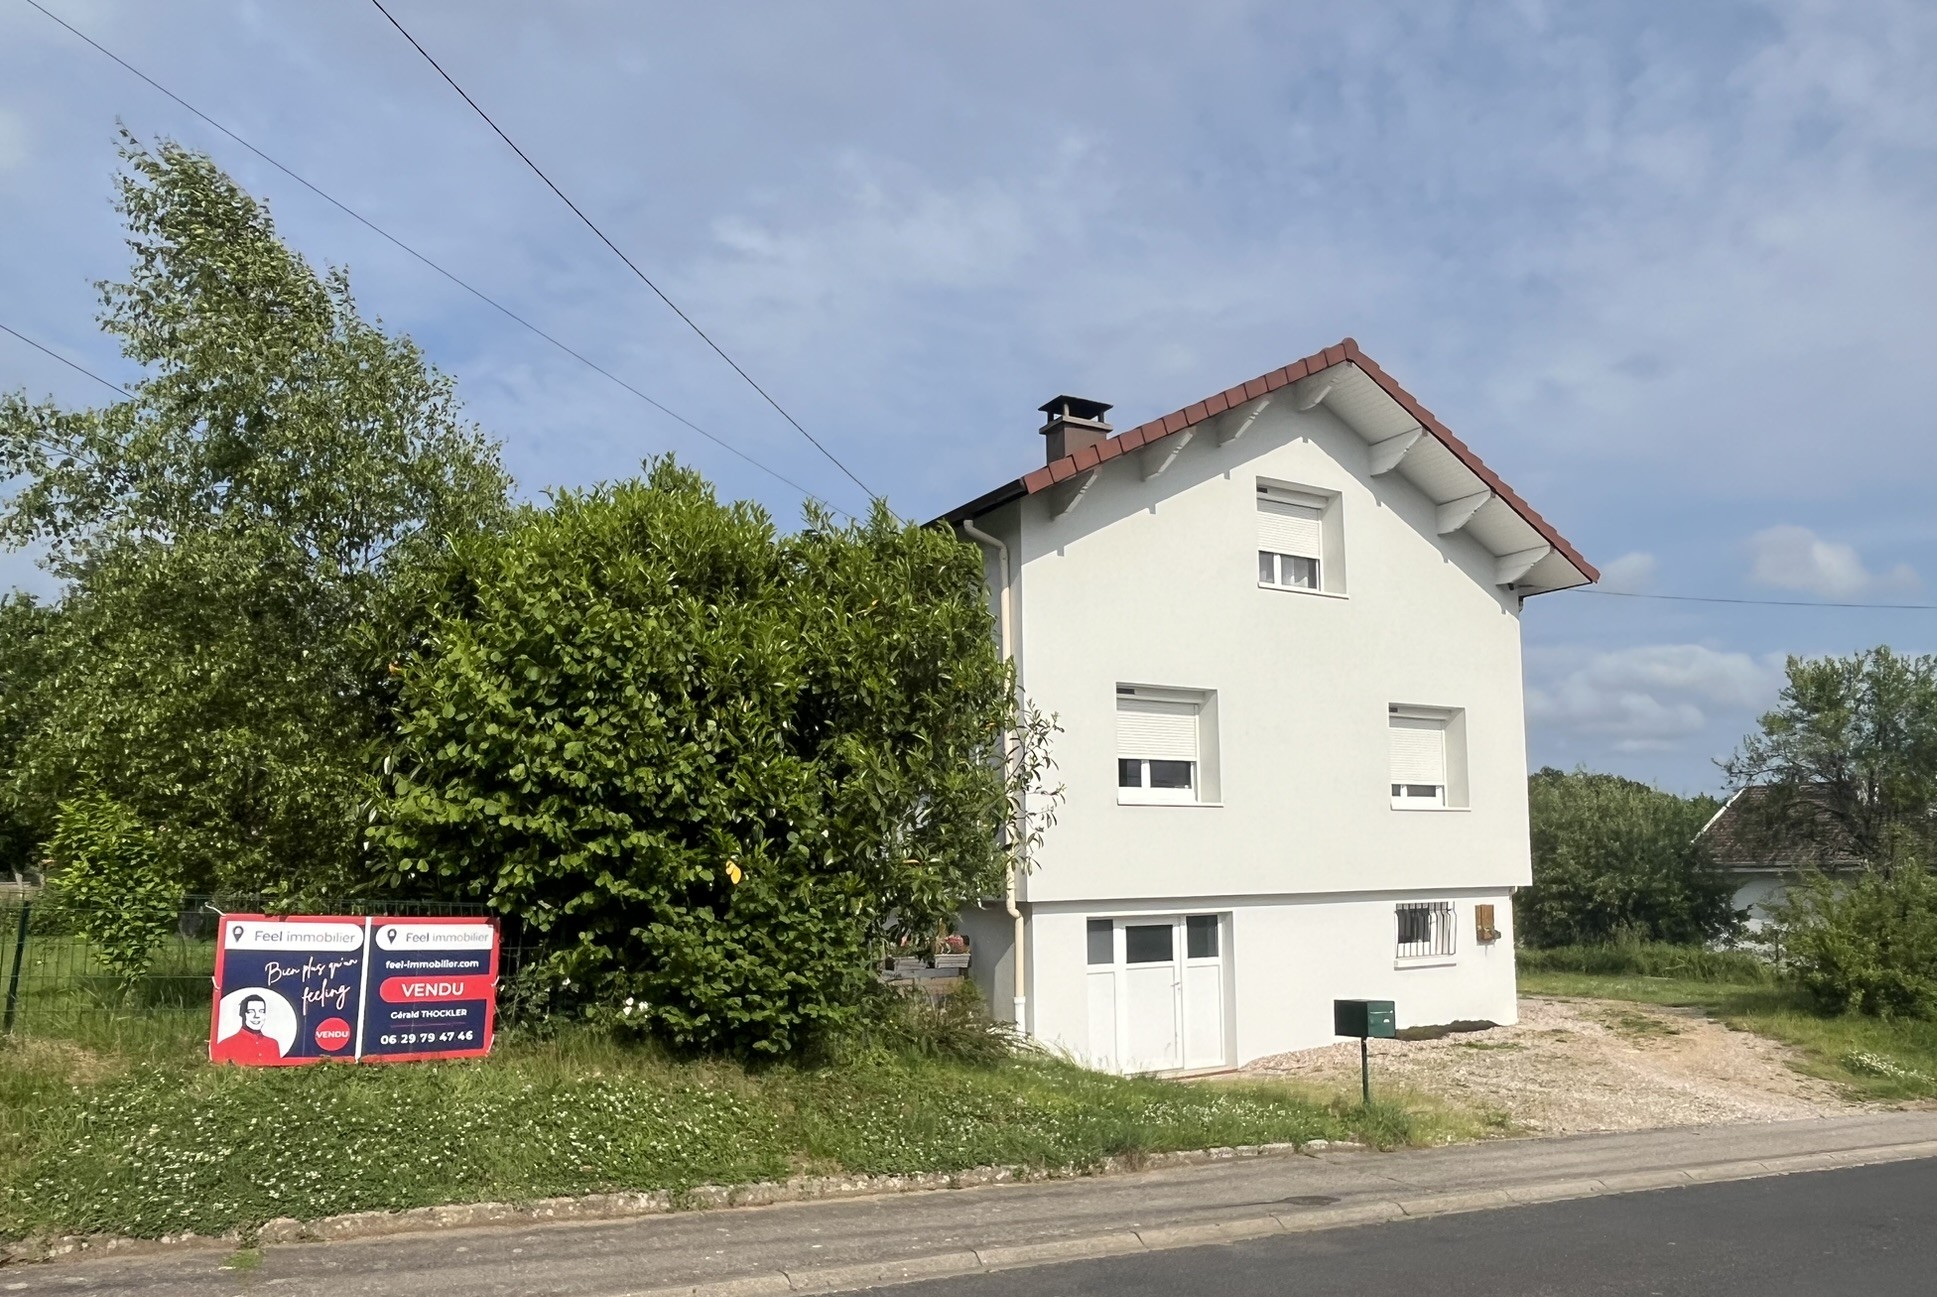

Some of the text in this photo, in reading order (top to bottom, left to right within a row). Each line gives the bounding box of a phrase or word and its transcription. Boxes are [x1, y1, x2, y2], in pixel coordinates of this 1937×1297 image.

[254, 930, 355, 944] Feel immobilier
[406, 932, 489, 942] Feel immobilier
[386, 960, 479, 969] feel-immobilier.com
[265, 962, 300, 986] Bien
[402, 982, 464, 997] VENDU
[301, 979, 351, 1016] feeling
[390, 1009, 467, 1019] Gérald THOCKLER
[316, 1031, 349, 1039] VENDU
[380, 1031, 473, 1045] 06 29 79 47 46
